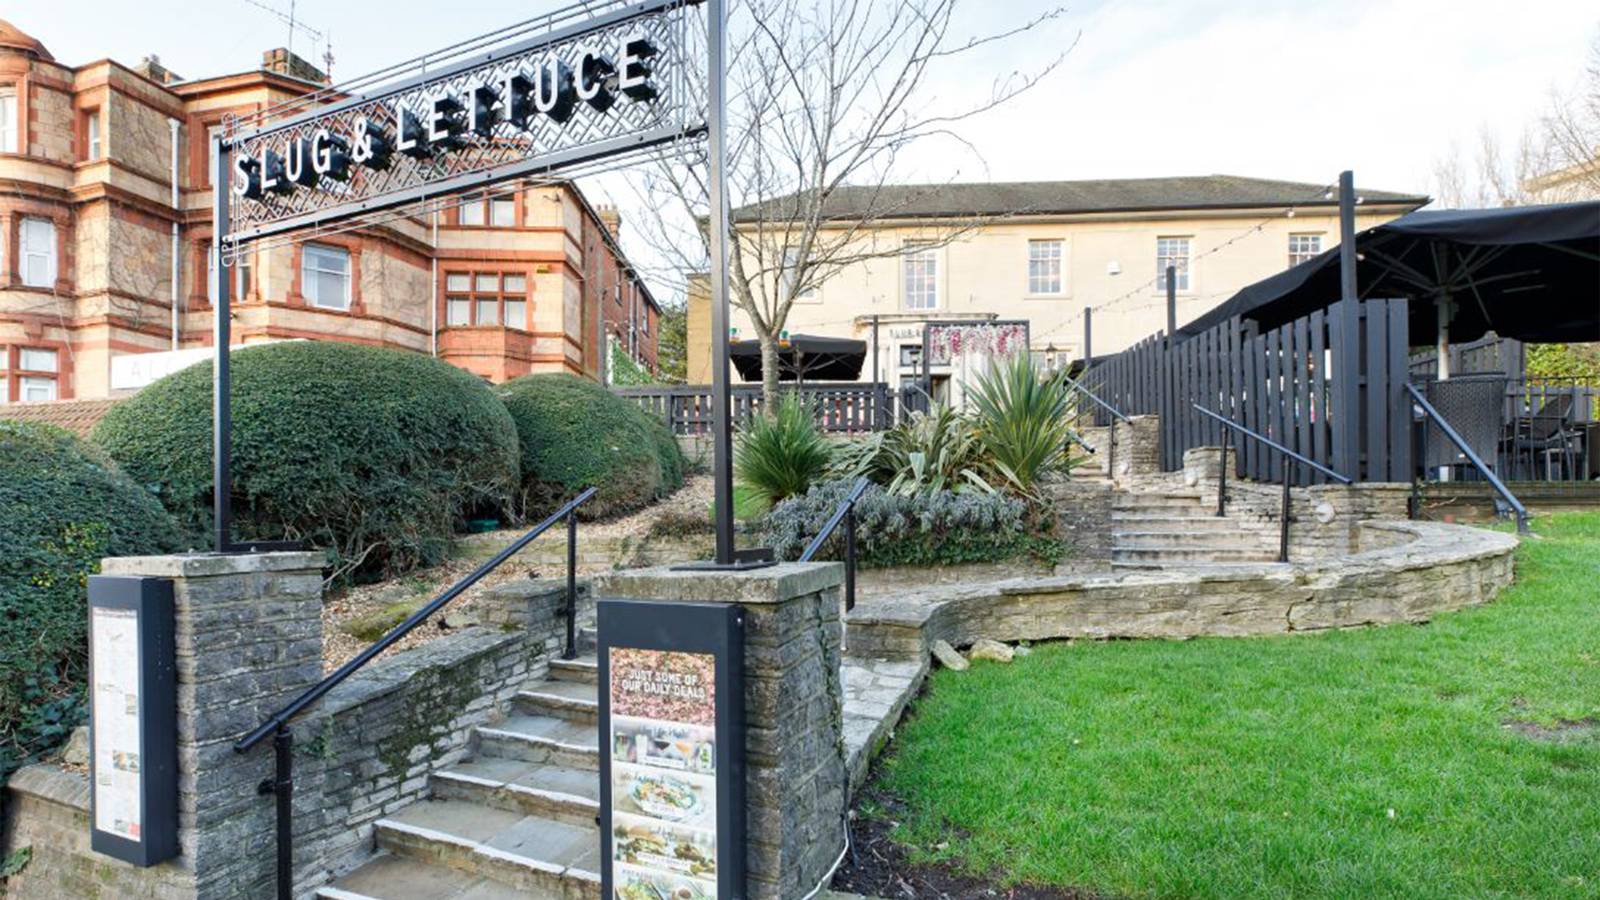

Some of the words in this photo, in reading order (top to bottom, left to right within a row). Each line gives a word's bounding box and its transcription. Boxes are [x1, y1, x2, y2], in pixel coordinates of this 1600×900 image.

[233, 128, 334, 197] SLUG
[351, 115, 375, 165] &
[395, 34, 652, 152] LETTUCE
[629, 670, 653, 682] JUST
[655, 672, 682, 684] SOME
[684, 674, 698, 686] OF
[621, 679, 642, 692] OUR
[643, 682, 670, 695] DAILY
[674, 685, 705, 700] DEALS
